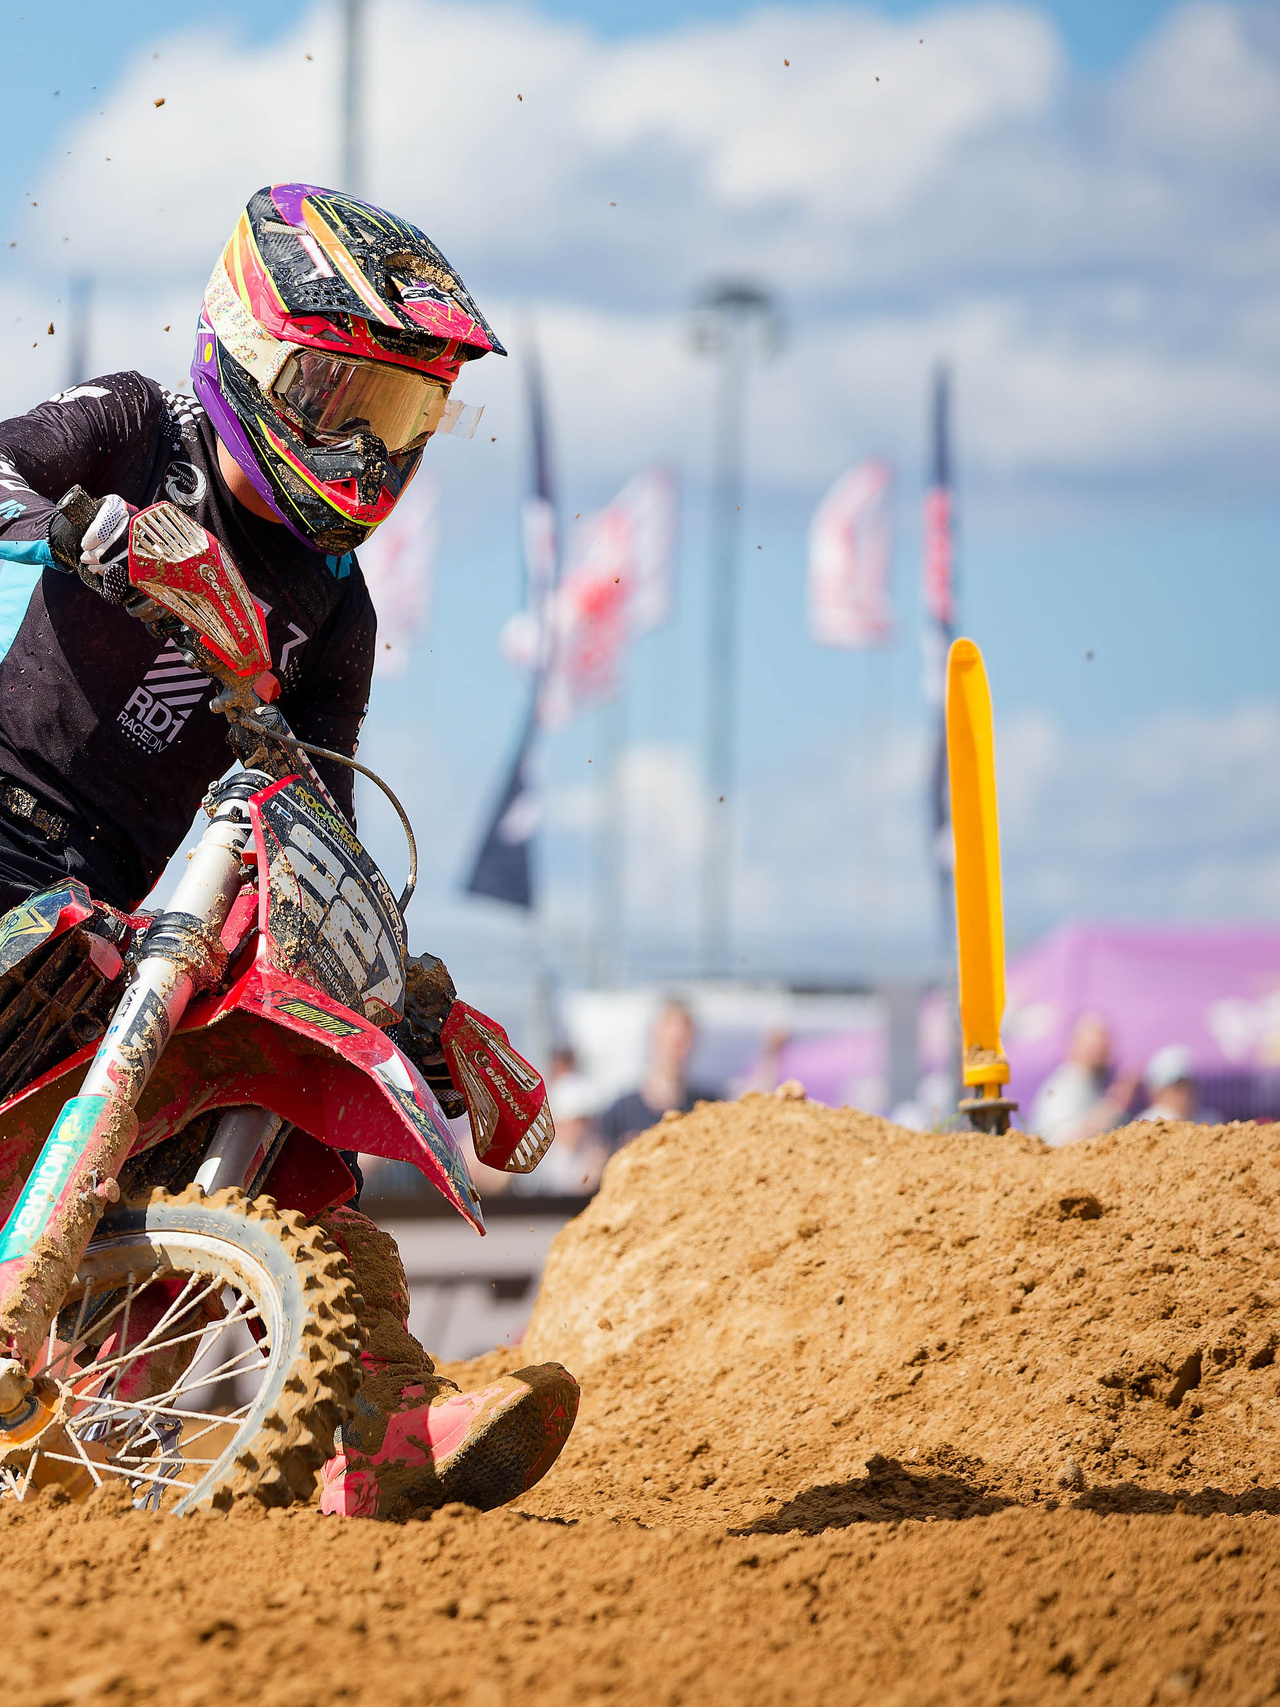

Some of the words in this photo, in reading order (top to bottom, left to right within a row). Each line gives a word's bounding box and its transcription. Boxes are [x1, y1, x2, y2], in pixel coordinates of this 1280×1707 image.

[124, 685, 185, 744] RD1
[294, 785, 364, 858] ROCKSTAR
[299, 800, 331, 835] ENERGY
[332, 832, 355, 859] DRINK
[321, 944, 343, 976] IGOR
[118, 986, 140, 1018] XACT
[10, 1143, 73, 1239] MOTOREX
